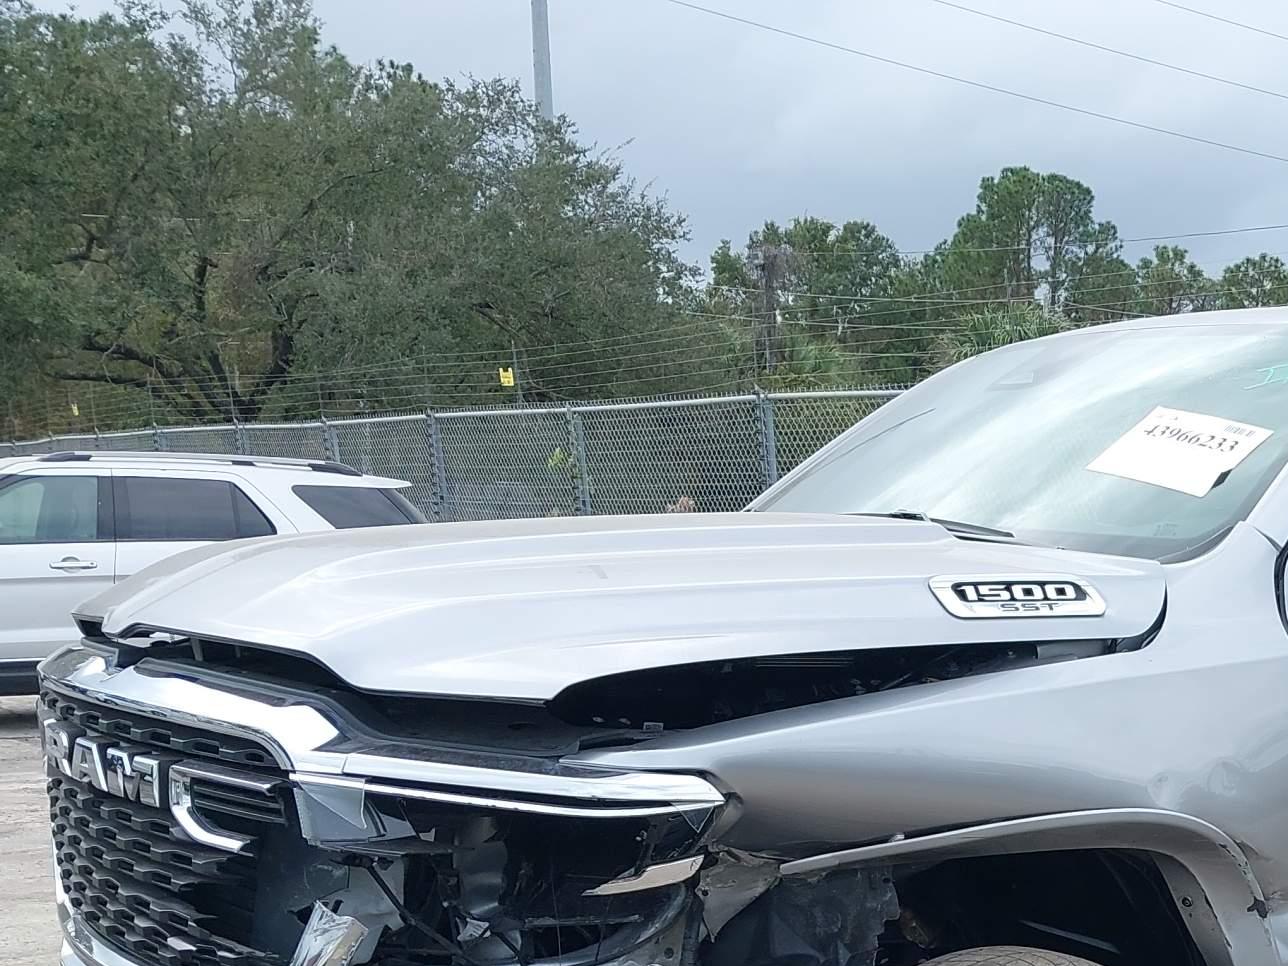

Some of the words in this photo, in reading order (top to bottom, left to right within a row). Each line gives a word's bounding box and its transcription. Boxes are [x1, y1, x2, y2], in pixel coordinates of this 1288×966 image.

[1144, 424, 1239, 452] 43966233
[955, 584, 1077, 601] 1500
[1000, 602, 1059, 612] SST
[43, 719, 160, 808] RAM
